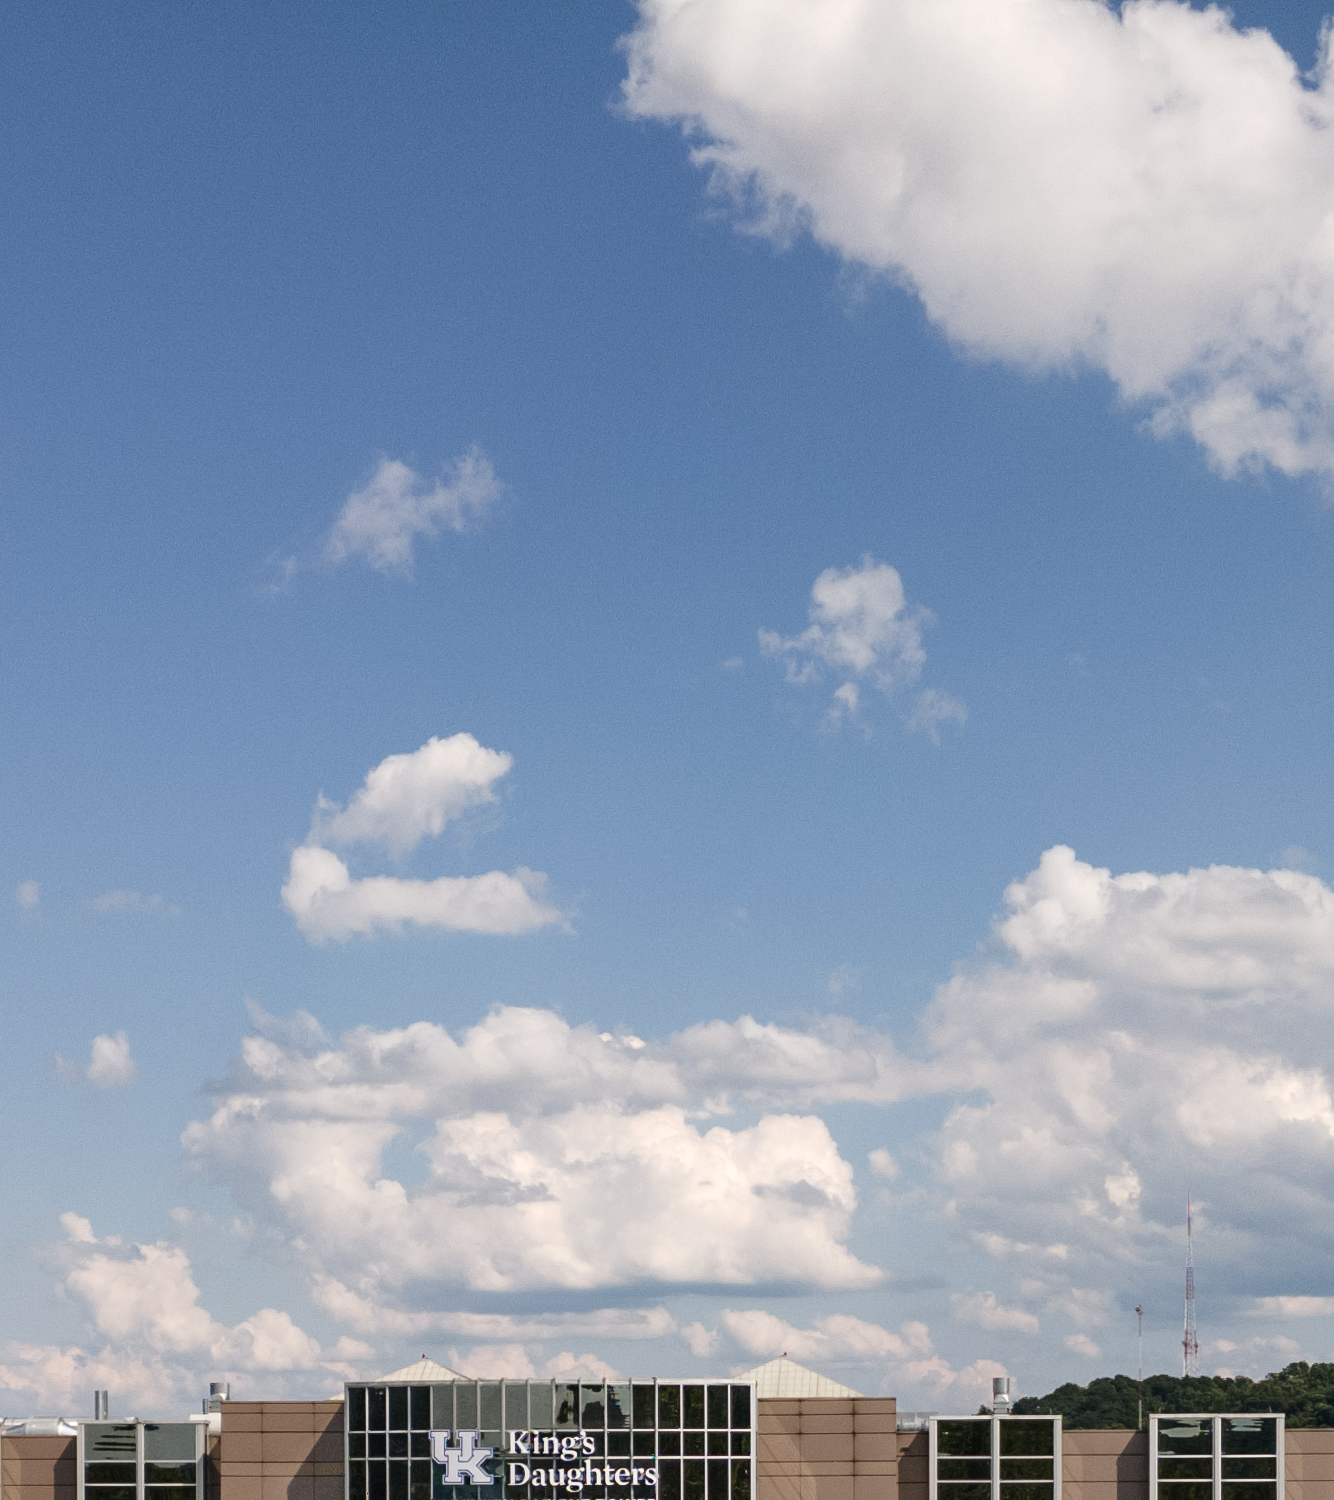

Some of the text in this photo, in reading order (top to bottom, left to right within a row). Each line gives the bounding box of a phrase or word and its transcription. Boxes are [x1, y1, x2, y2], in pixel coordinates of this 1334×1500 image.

[429, 1430, 494, 1485] UK
[508, 1430, 595, 1461] King's
[508, 1458, 658, 1493] Daughters
